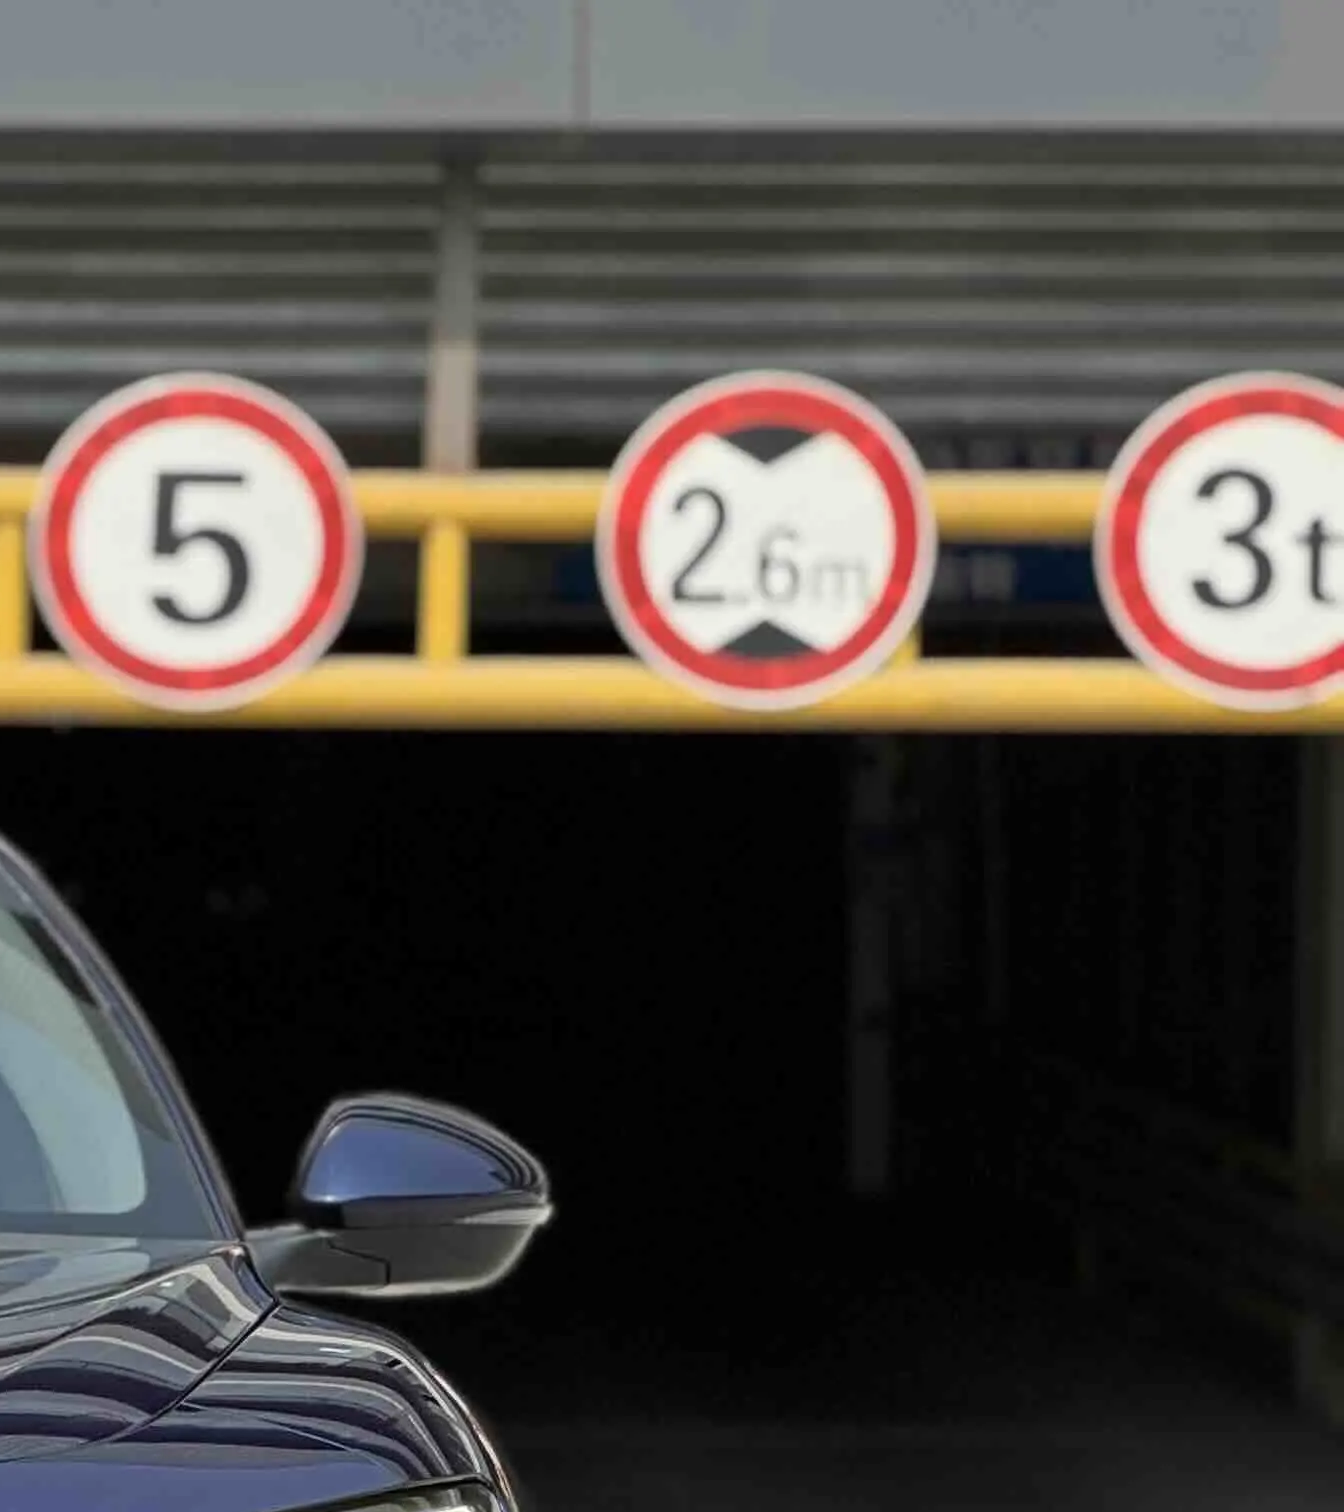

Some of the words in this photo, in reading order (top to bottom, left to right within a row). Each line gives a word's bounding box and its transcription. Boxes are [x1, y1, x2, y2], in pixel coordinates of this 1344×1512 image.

[152, 470, 252, 626] 5
[670, 486, 870, 606] 2.6m
[1192, 468, 1344, 610] 3t
